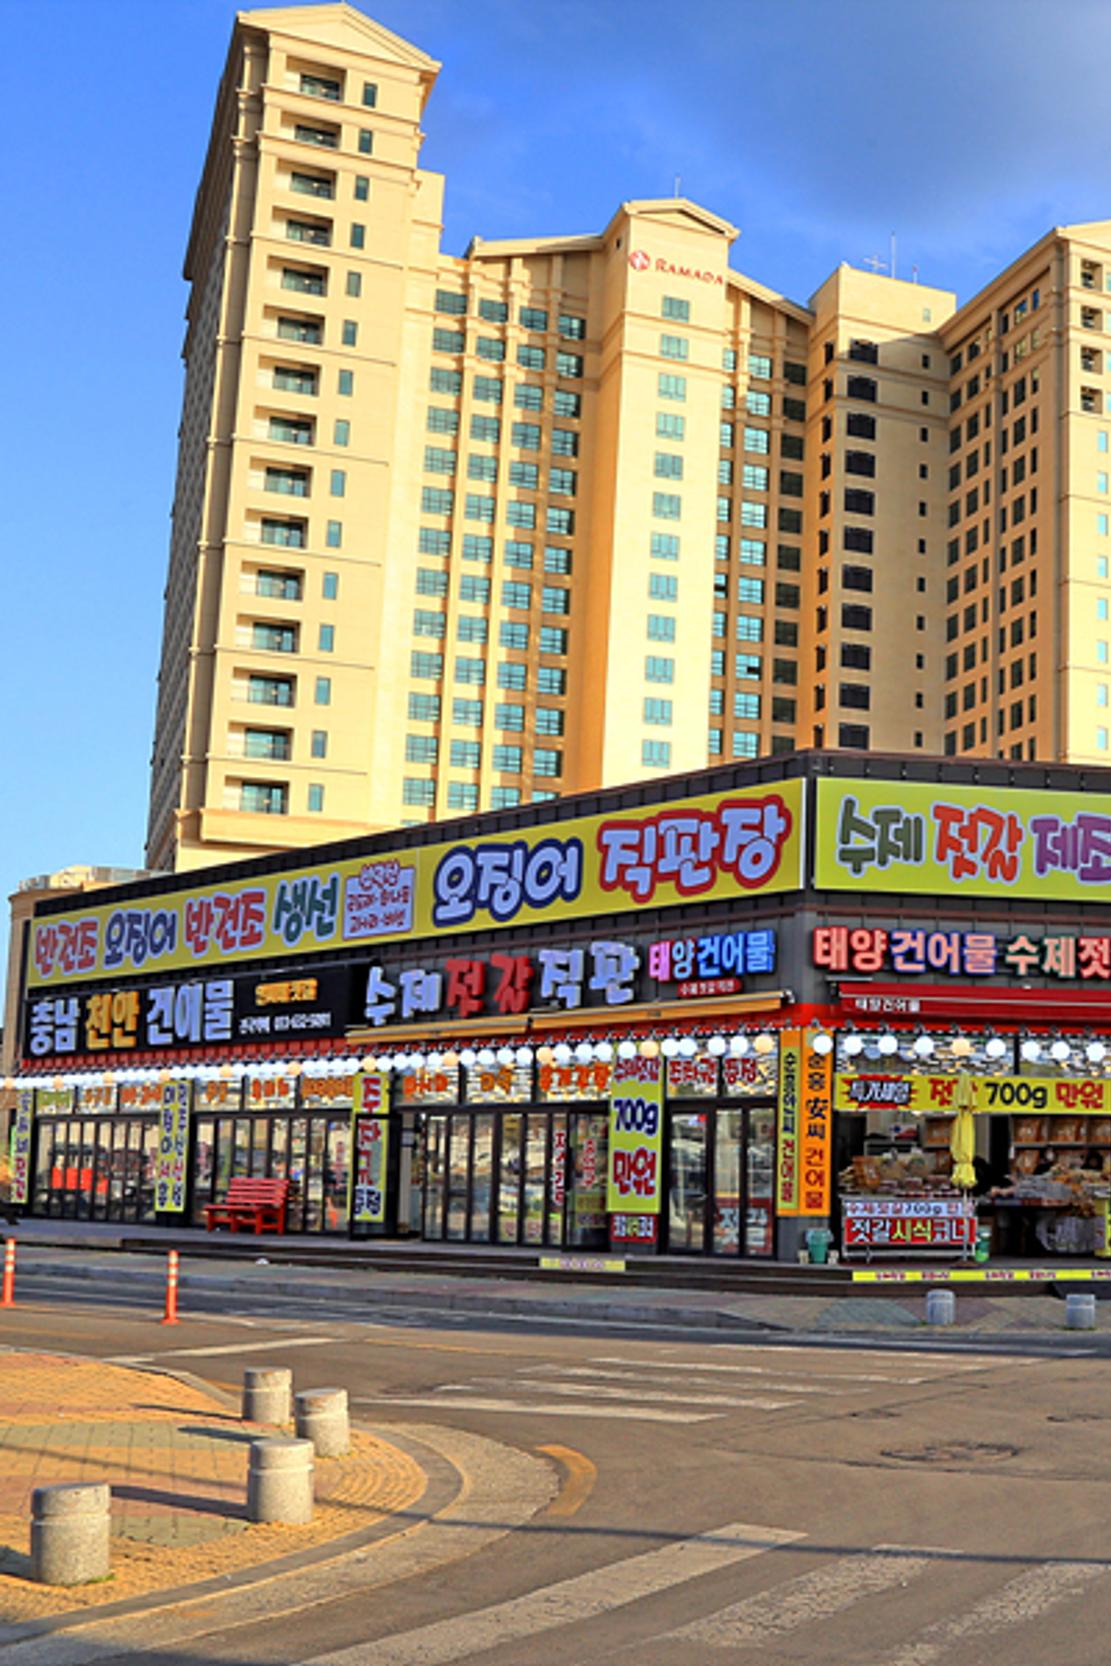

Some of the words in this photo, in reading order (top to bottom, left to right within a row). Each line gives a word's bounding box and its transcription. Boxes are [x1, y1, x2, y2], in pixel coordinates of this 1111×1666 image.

[655, 258, 723, 285] RAMADA
[433, 838, 583, 928] 오징어
[598, 795, 792, 902] 직판장
[838, 796, 923, 875] 수제
[932, 804, 1024, 882] 젓갈
[35, 919, 98, 975] 반건조
[104, 911, 177, 965] 오징어
[185, 892, 265, 953] 반건조
[274, 876, 338, 942] 생선
[813, 925, 998, 976] 태양건어물
[365, 966, 443, 1025] 수제
[445, 955, 535, 1017] 젓갈
[539, 941, 641, 1009] 직판
[648, 928, 776, 983] 태양건어물
[30, 997, 80, 1055] 충남
[86, 991, 140, 1050] 천안
[147, 980, 234, 1045] 건어물
[855, 998, 920, 1013] 태양건어물
[613, 1098, 659, 1137] 700g
[928, 1078, 979, 1107] 젓
[985, 1081, 1048, 1109] 700g
[1055, 1081, 1104, 1109] 만원
[613, 1147, 657, 1197] 만원
[805, 1147, 825, 1209] 건어물
